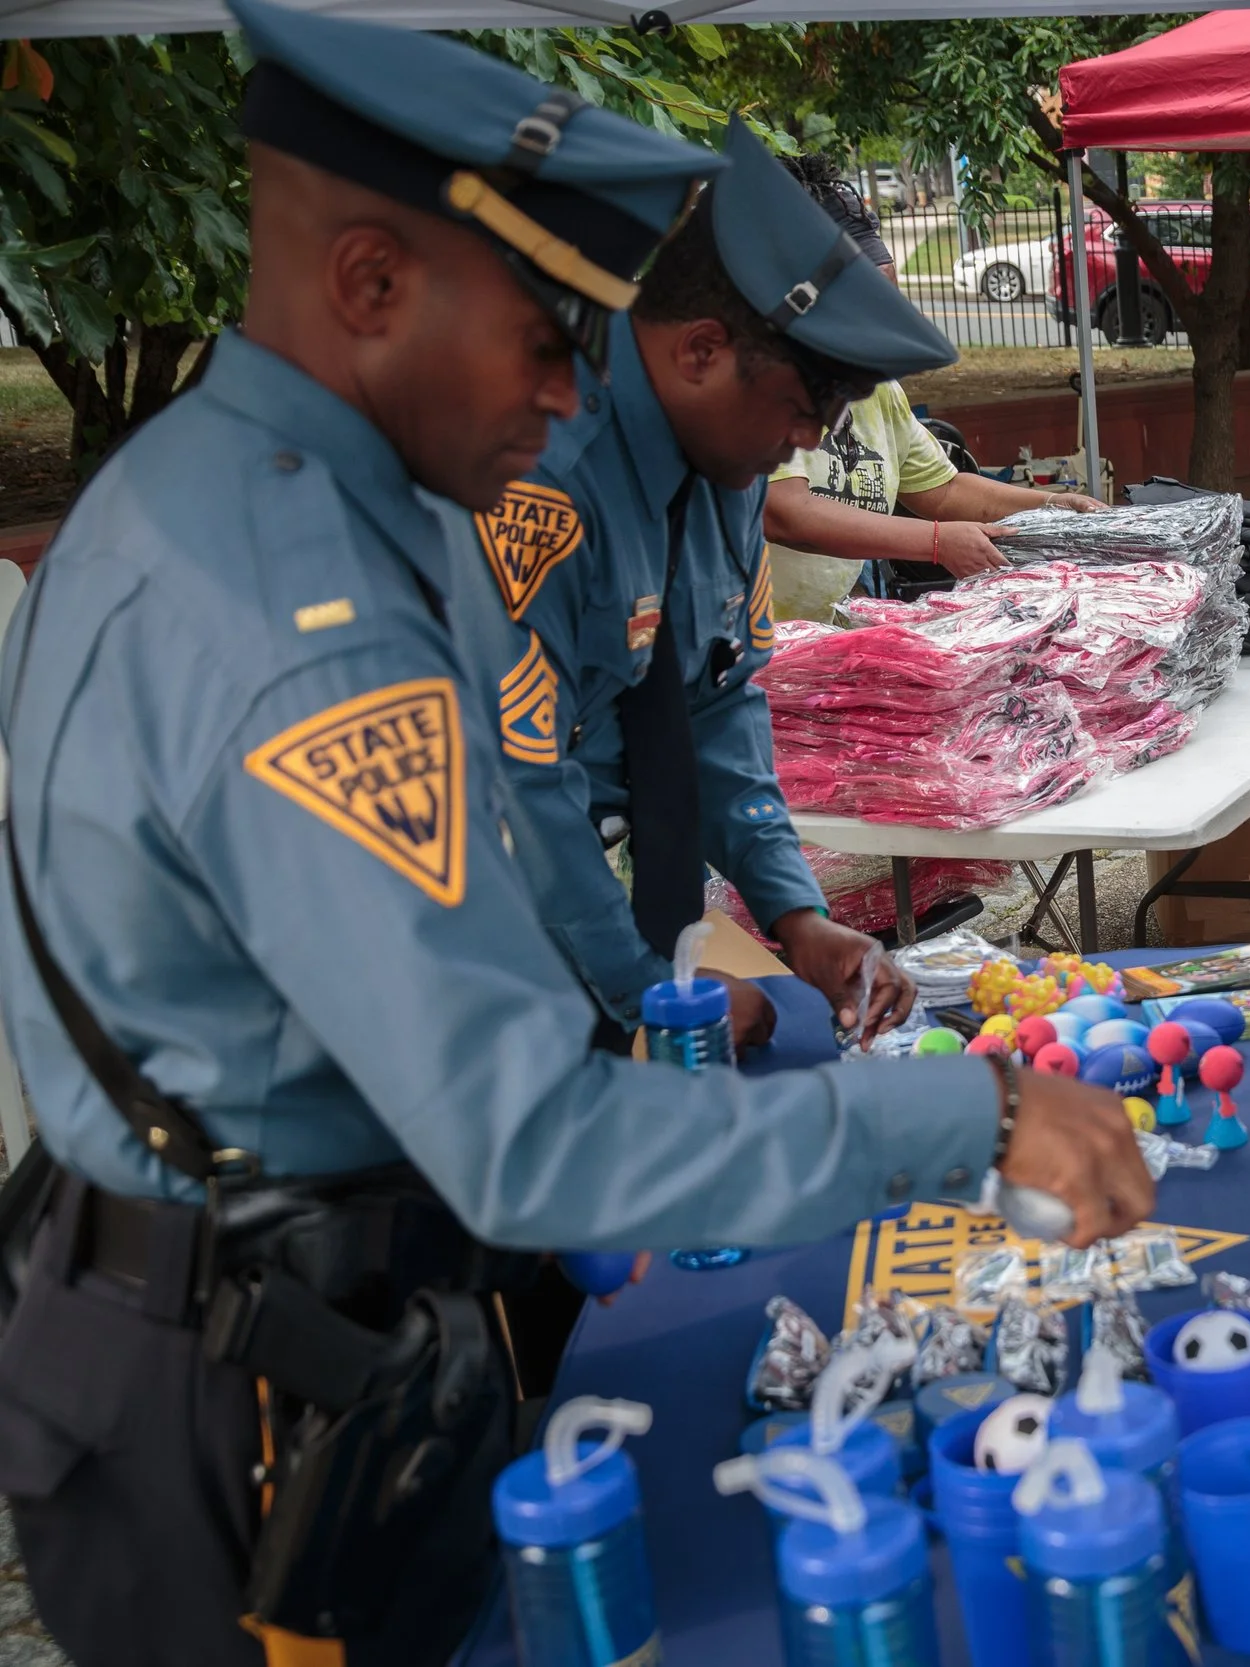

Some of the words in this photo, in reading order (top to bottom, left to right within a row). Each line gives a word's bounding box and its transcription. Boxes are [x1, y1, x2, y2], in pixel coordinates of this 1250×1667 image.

[490, 499, 570, 532] STATE
[866, 501, 888, 512] PARK
[496, 521, 559, 550] POLICE
[306, 707, 437, 780] STATE
[891, 1215, 955, 1298] TATE
